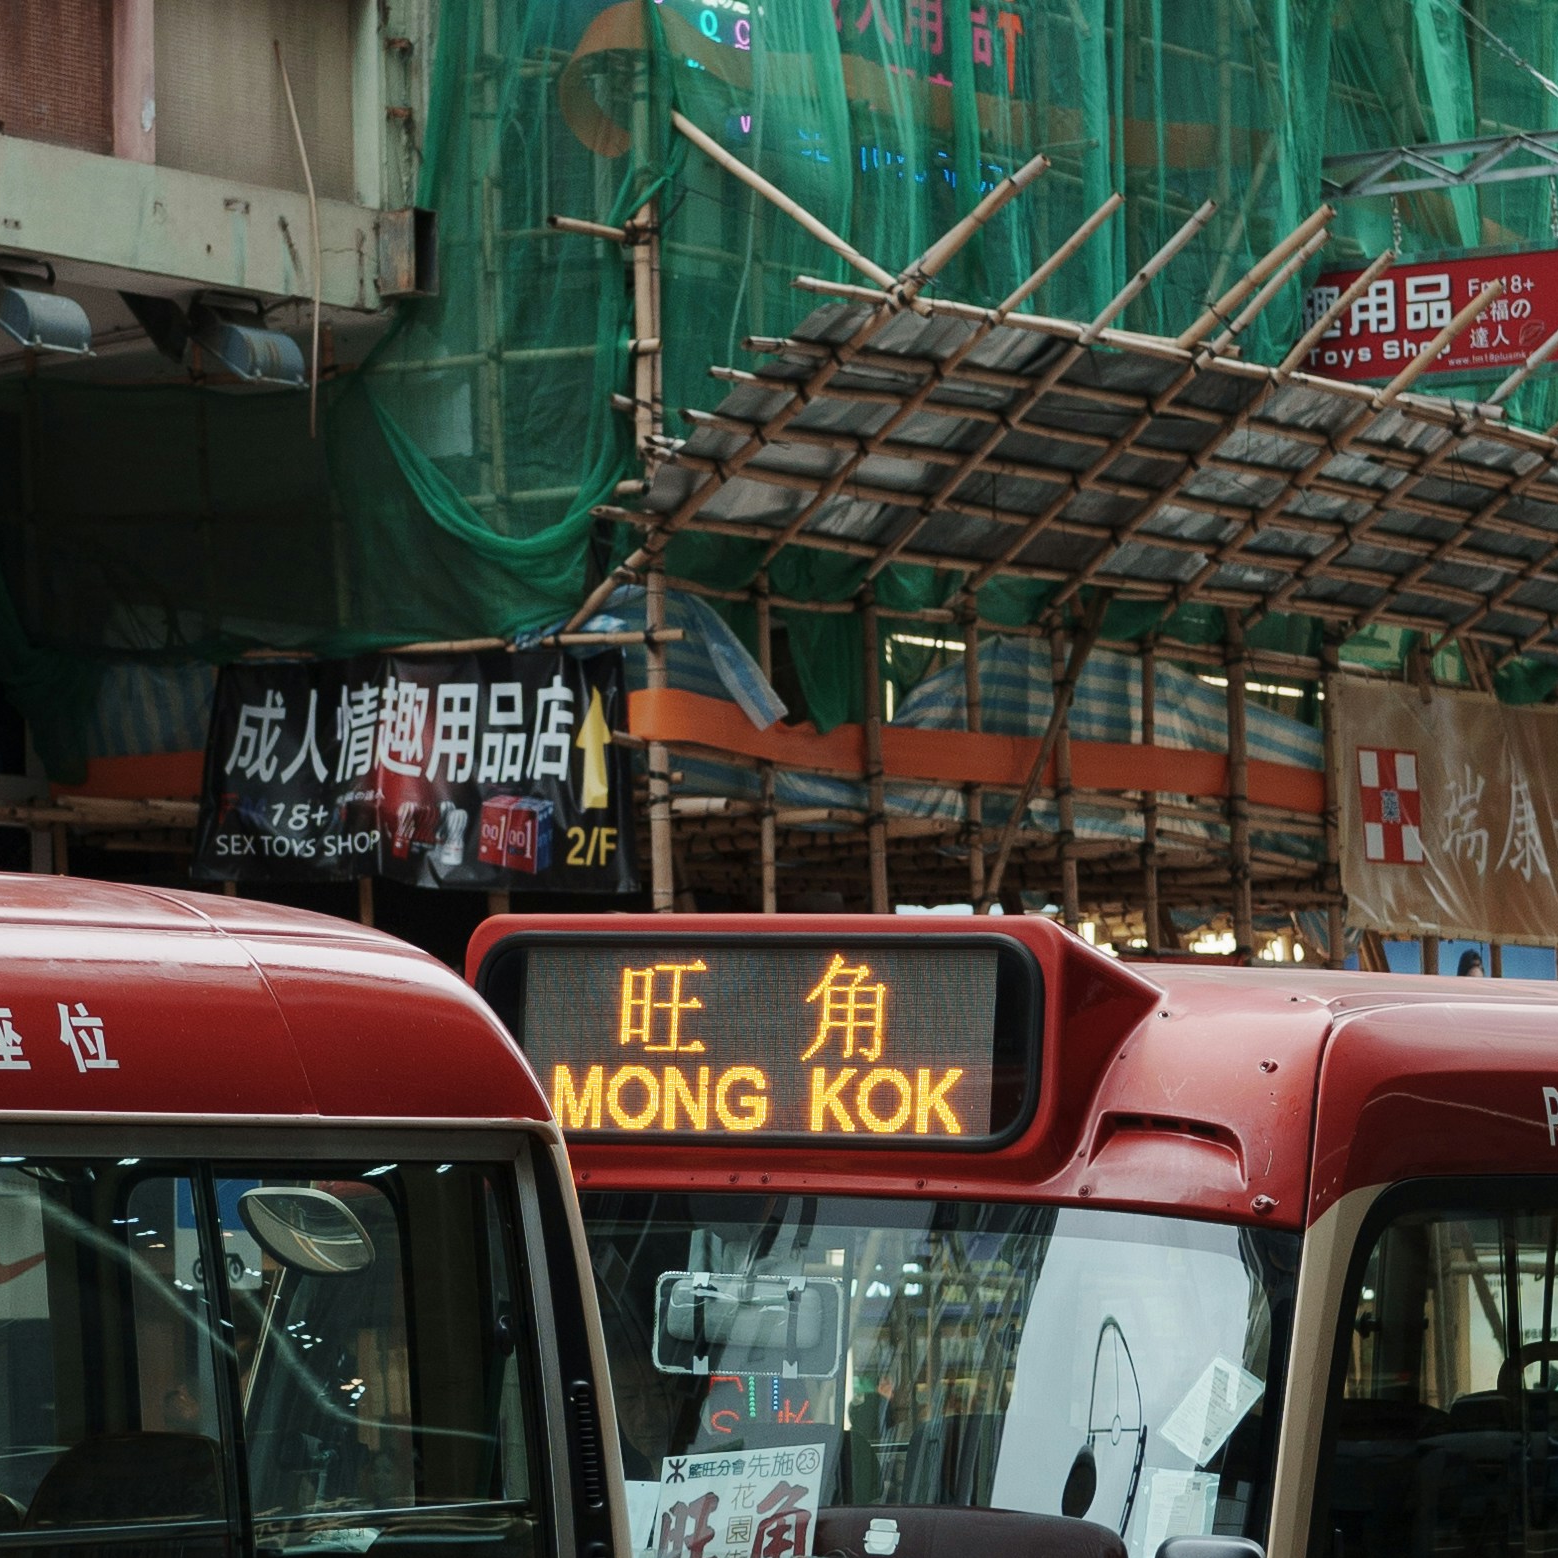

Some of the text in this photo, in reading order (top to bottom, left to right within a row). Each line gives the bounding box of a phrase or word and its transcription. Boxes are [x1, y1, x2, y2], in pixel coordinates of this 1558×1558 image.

[1309, 346, 1373, 370] Toys
[224, 674, 575, 784] 成人情趣用品店
[271, 800, 330, 831] 18+
[215, 829, 382, 858] SEX TOYS SHOP
[566, 826, 619, 867] 2/F
[619, 953, 887, 1063] 旺角
[552, 1064, 964, 1135] MONG KOK
